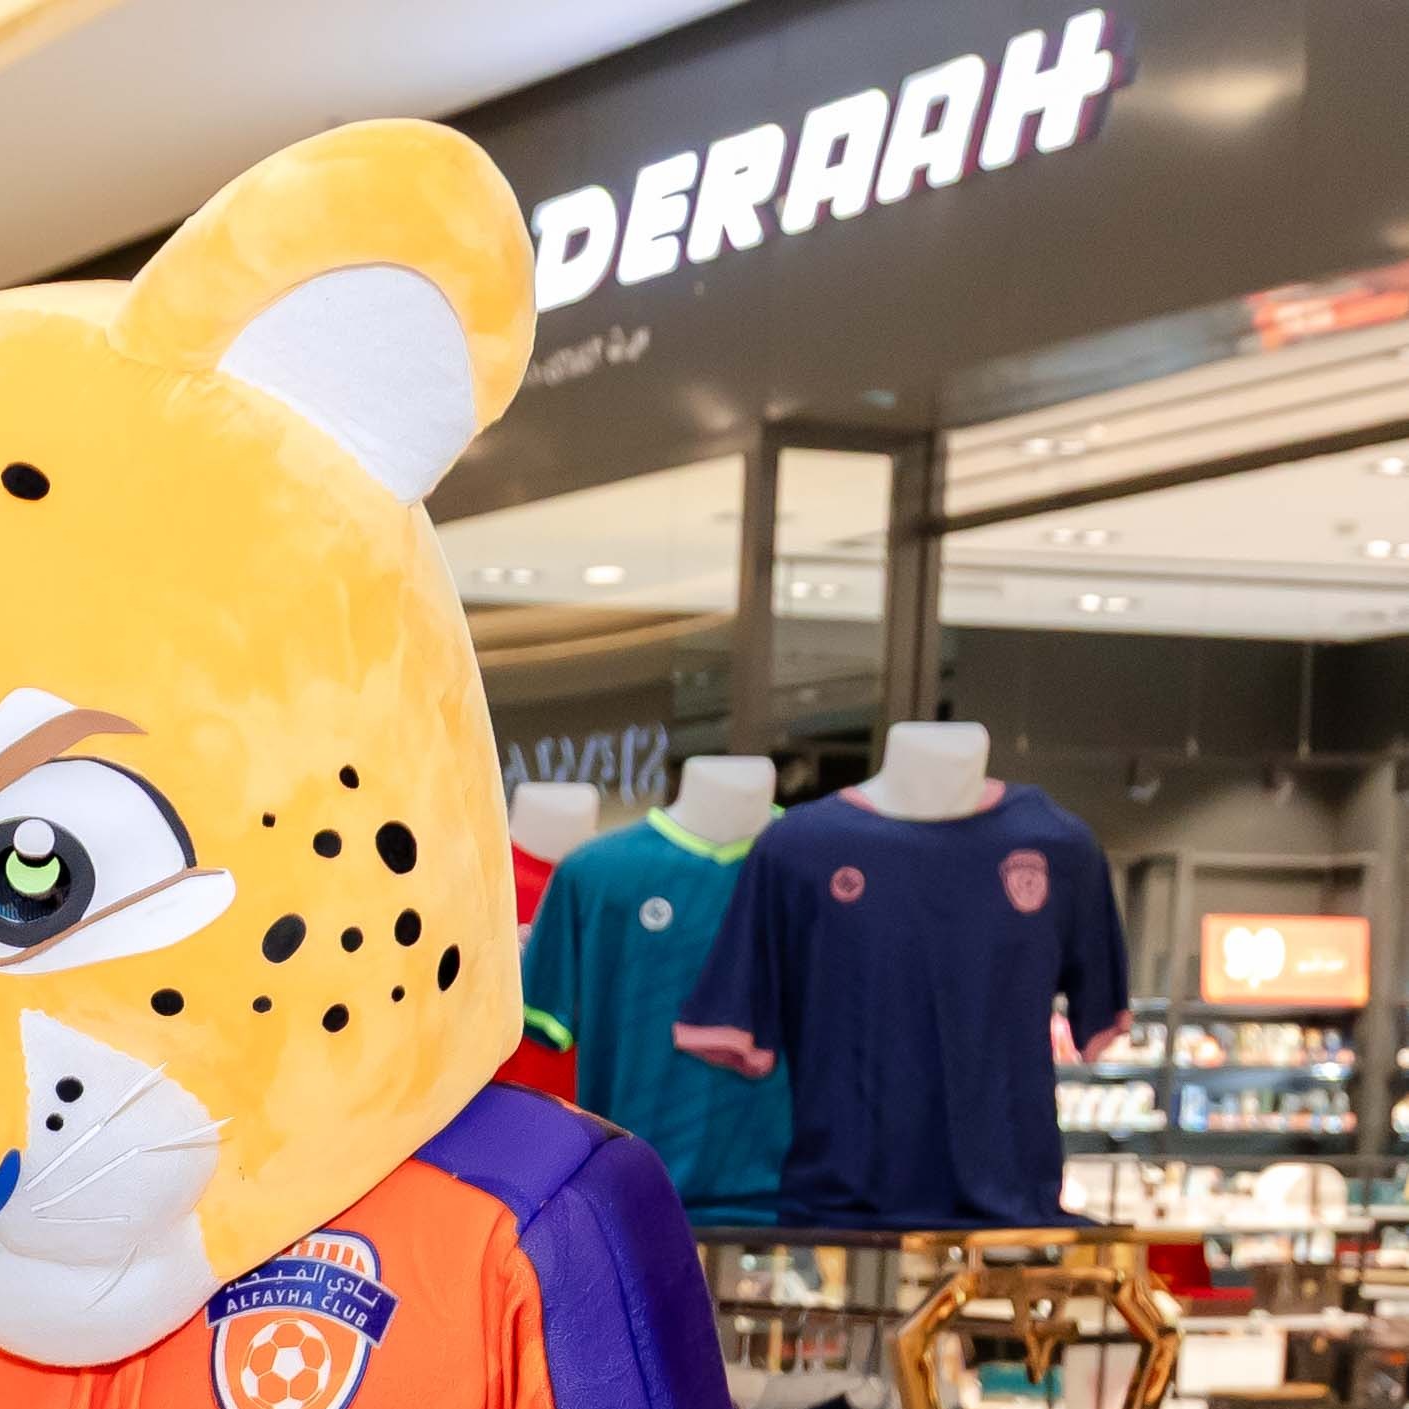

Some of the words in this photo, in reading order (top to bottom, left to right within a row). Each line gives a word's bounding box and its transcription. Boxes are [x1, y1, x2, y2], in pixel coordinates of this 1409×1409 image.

[531, 7, 1113, 312] DERAAH
[226, 1264, 325, 1294] الفيح
[327, 1276, 381, 1308] نادي
[226, 1288, 313, 1314] ALFAYHA
[321, 1295, 369, 1329] CLUB
